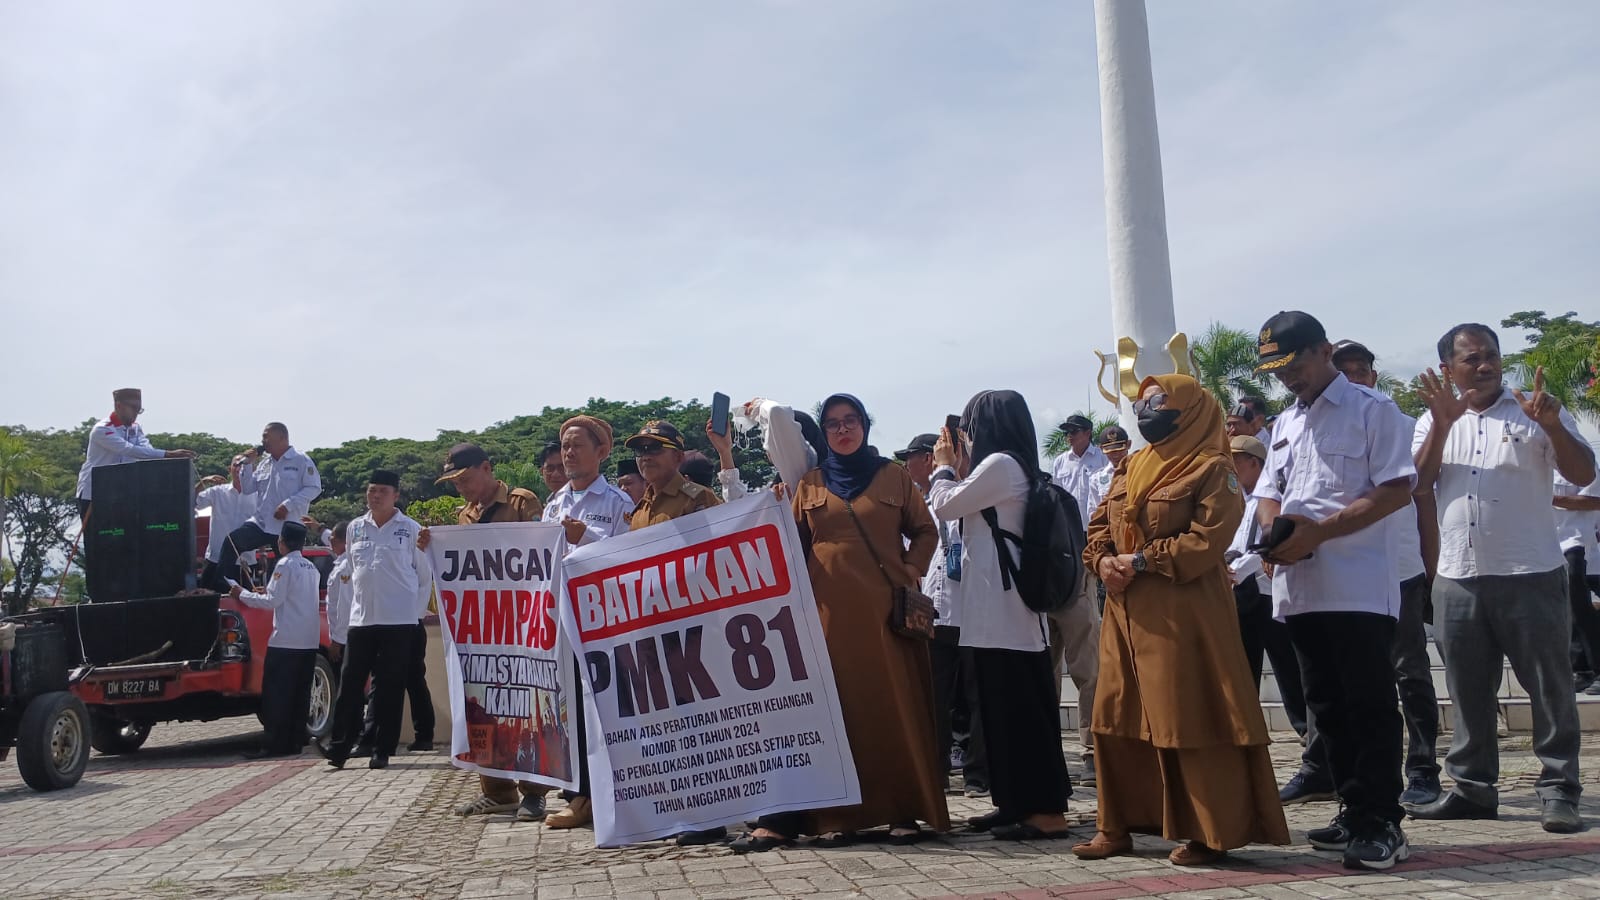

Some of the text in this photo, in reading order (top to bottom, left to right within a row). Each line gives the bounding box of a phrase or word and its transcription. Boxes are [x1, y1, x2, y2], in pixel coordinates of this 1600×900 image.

[576, 537, 777, 632] BATALKAN
[585, 605, 808, 718] PMK 81
[122, 681, 145, 693] 8227
[148, 680, 160, 692] BA
[486, 687, 530, 718] KAMI
[640, 723, 662, 739] ATAS
[663, 710, 718, 734] PERATURAN
[720, 701, 763, 723] MENTERI
[764, 692, 814, 713] KEUANGAN
[627, 753, 705, 780] PENGALOKASIAN
[706, 747, 735, 765] DANA
[736, 741, 761, 758] DESA
[763, 734, 796, 753] SETIAP
[797, 730, 825, 746] DESA,
[641, 721, 760, 758] NOMOR 108 TAHUN 2024
[671, 776, 690, 792] DAN
[691, 761, 758, 788] PENYALURAN
[760, 755, 784, 773] DANA
[786, 752, 812, 768] DESA
[653, 779, 767, 814] TAHUN ANGGARAN 2025
